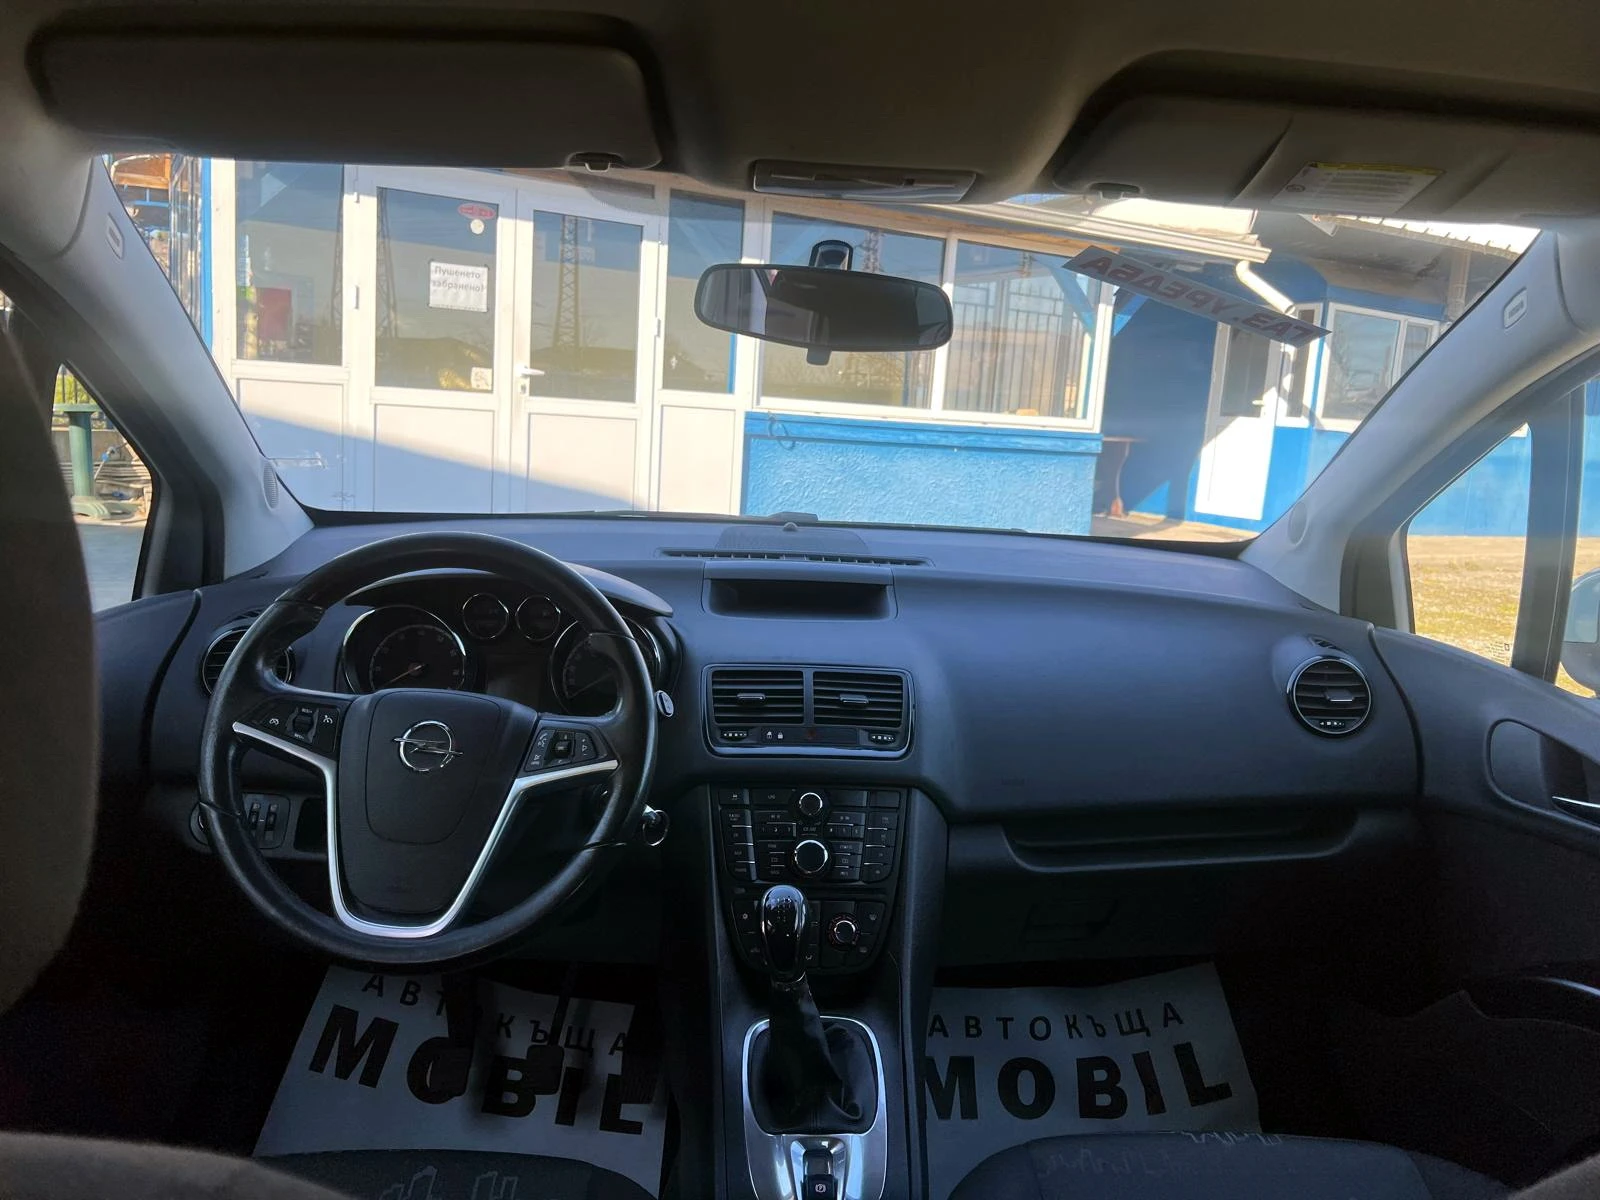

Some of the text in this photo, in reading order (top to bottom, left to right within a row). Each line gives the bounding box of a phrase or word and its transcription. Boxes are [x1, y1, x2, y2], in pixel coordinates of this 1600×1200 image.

[434, 265, 480, 279] Пушенето
[928, 1001, 1185, 1042] АВТОКЪЩА
[924, 1041, 1233, 1120] MOBIL
